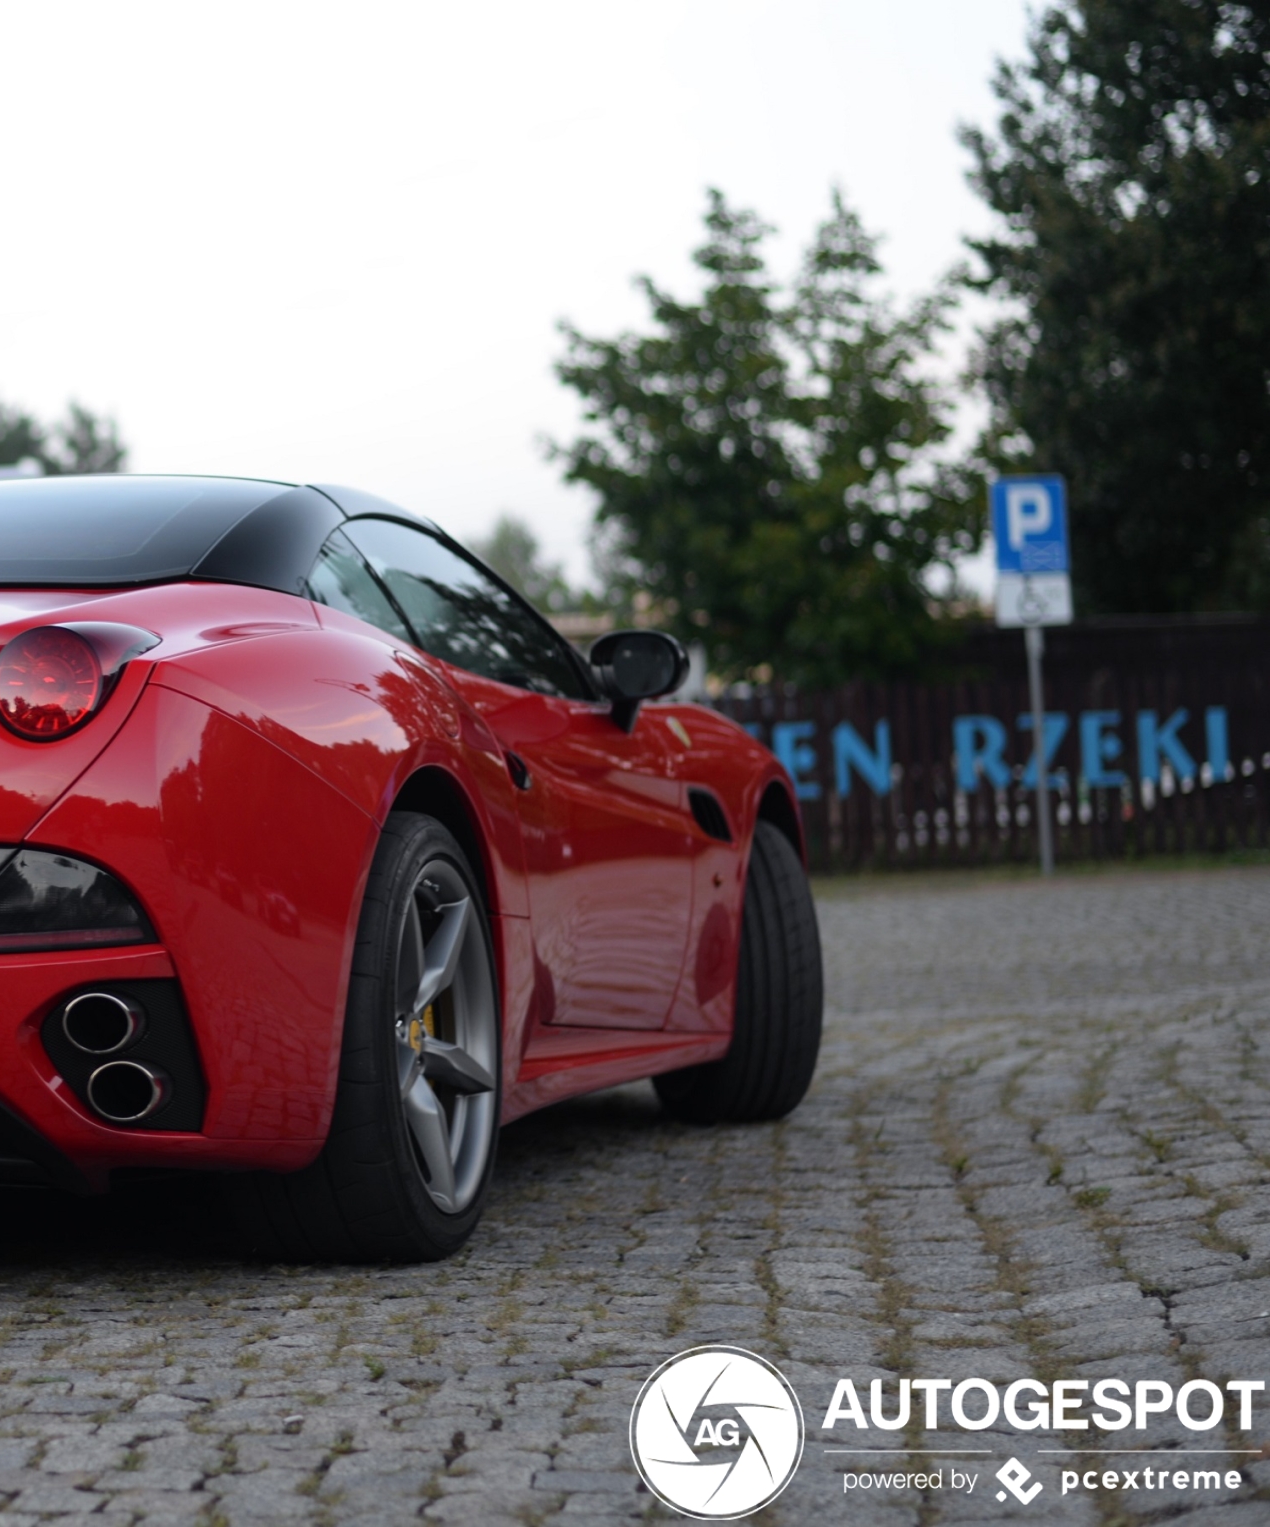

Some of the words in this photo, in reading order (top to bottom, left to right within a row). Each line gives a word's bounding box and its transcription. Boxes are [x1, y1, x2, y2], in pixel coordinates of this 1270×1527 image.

[1006, 483, 1052, 551] P
[743, 717, 894, 800] EN
[952, 706, 1229, 792] RZEKI
